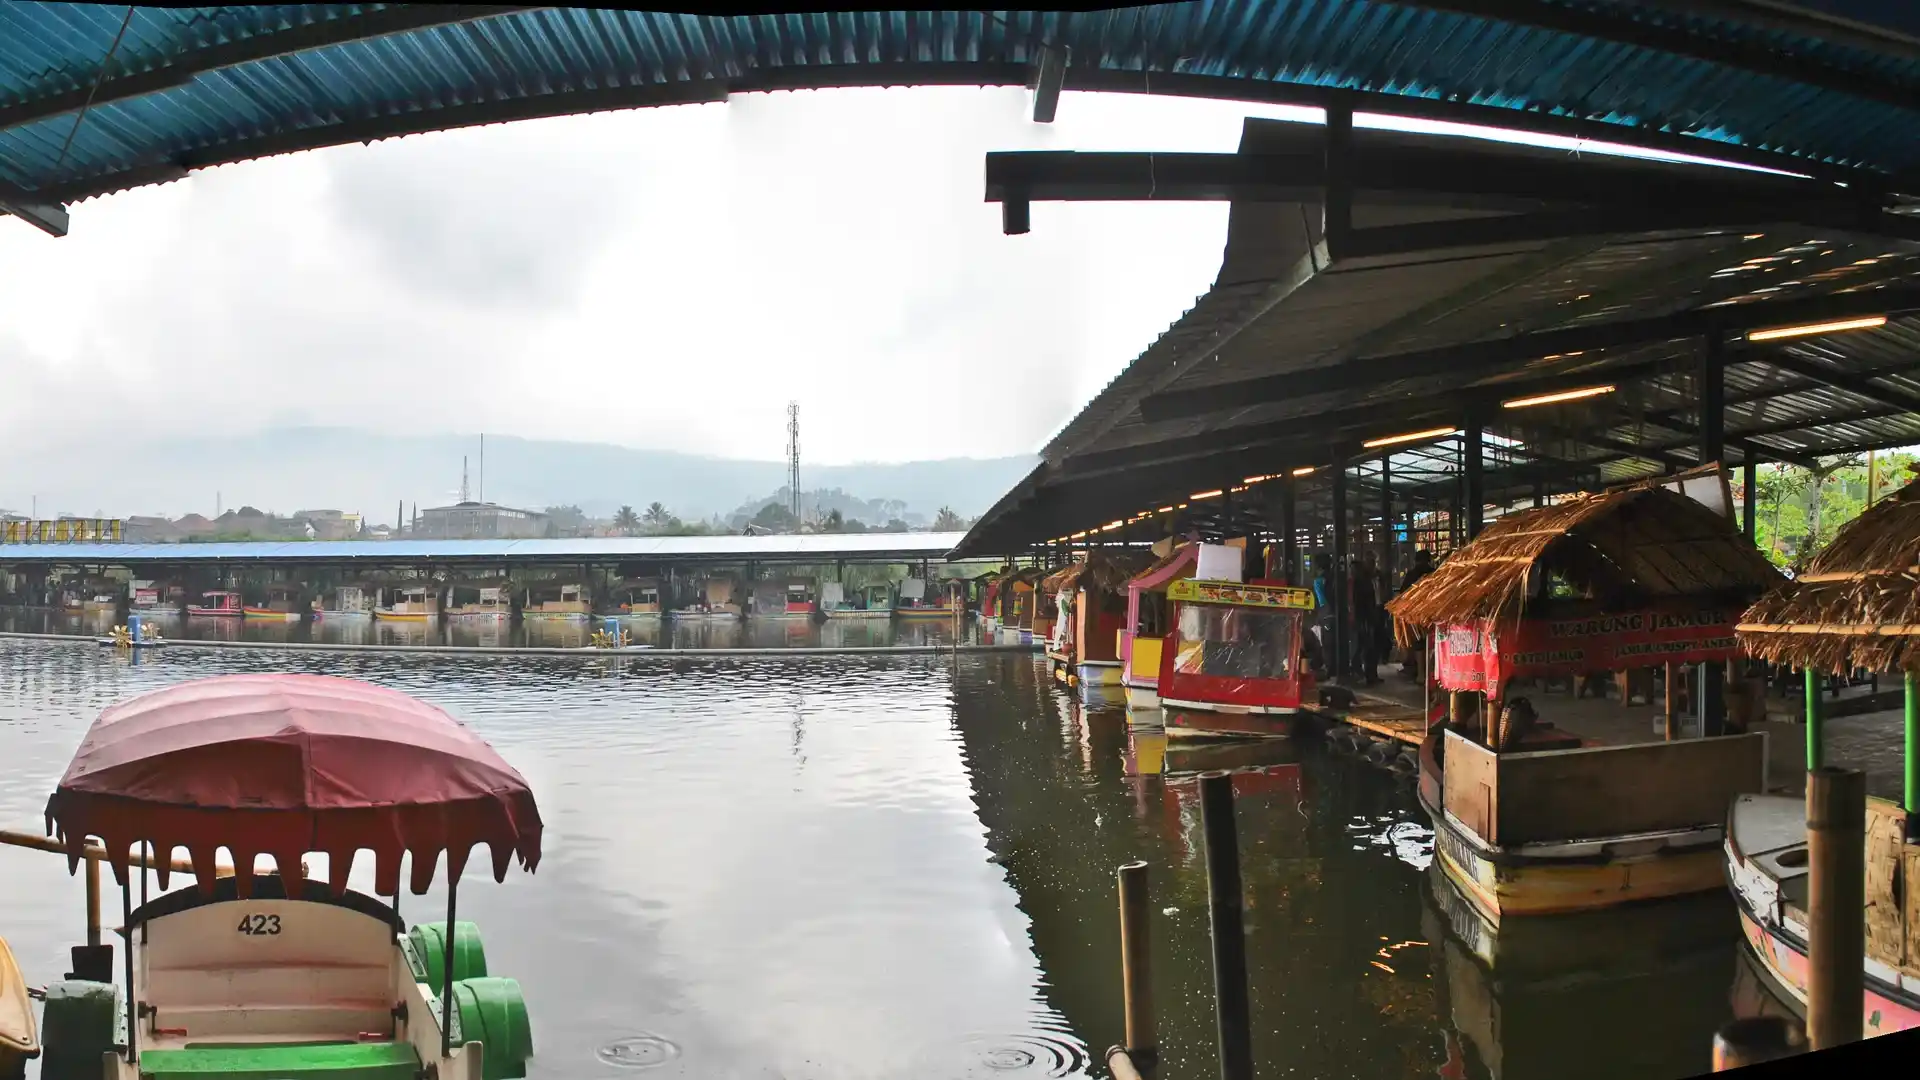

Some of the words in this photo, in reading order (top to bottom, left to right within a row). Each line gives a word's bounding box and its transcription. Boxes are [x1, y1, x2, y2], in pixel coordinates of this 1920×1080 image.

[1549, 614, 1643, 638] WARUNG
[1648, 610, 1728, 633] JAMUR
[238, 914, 281, 935] 423
